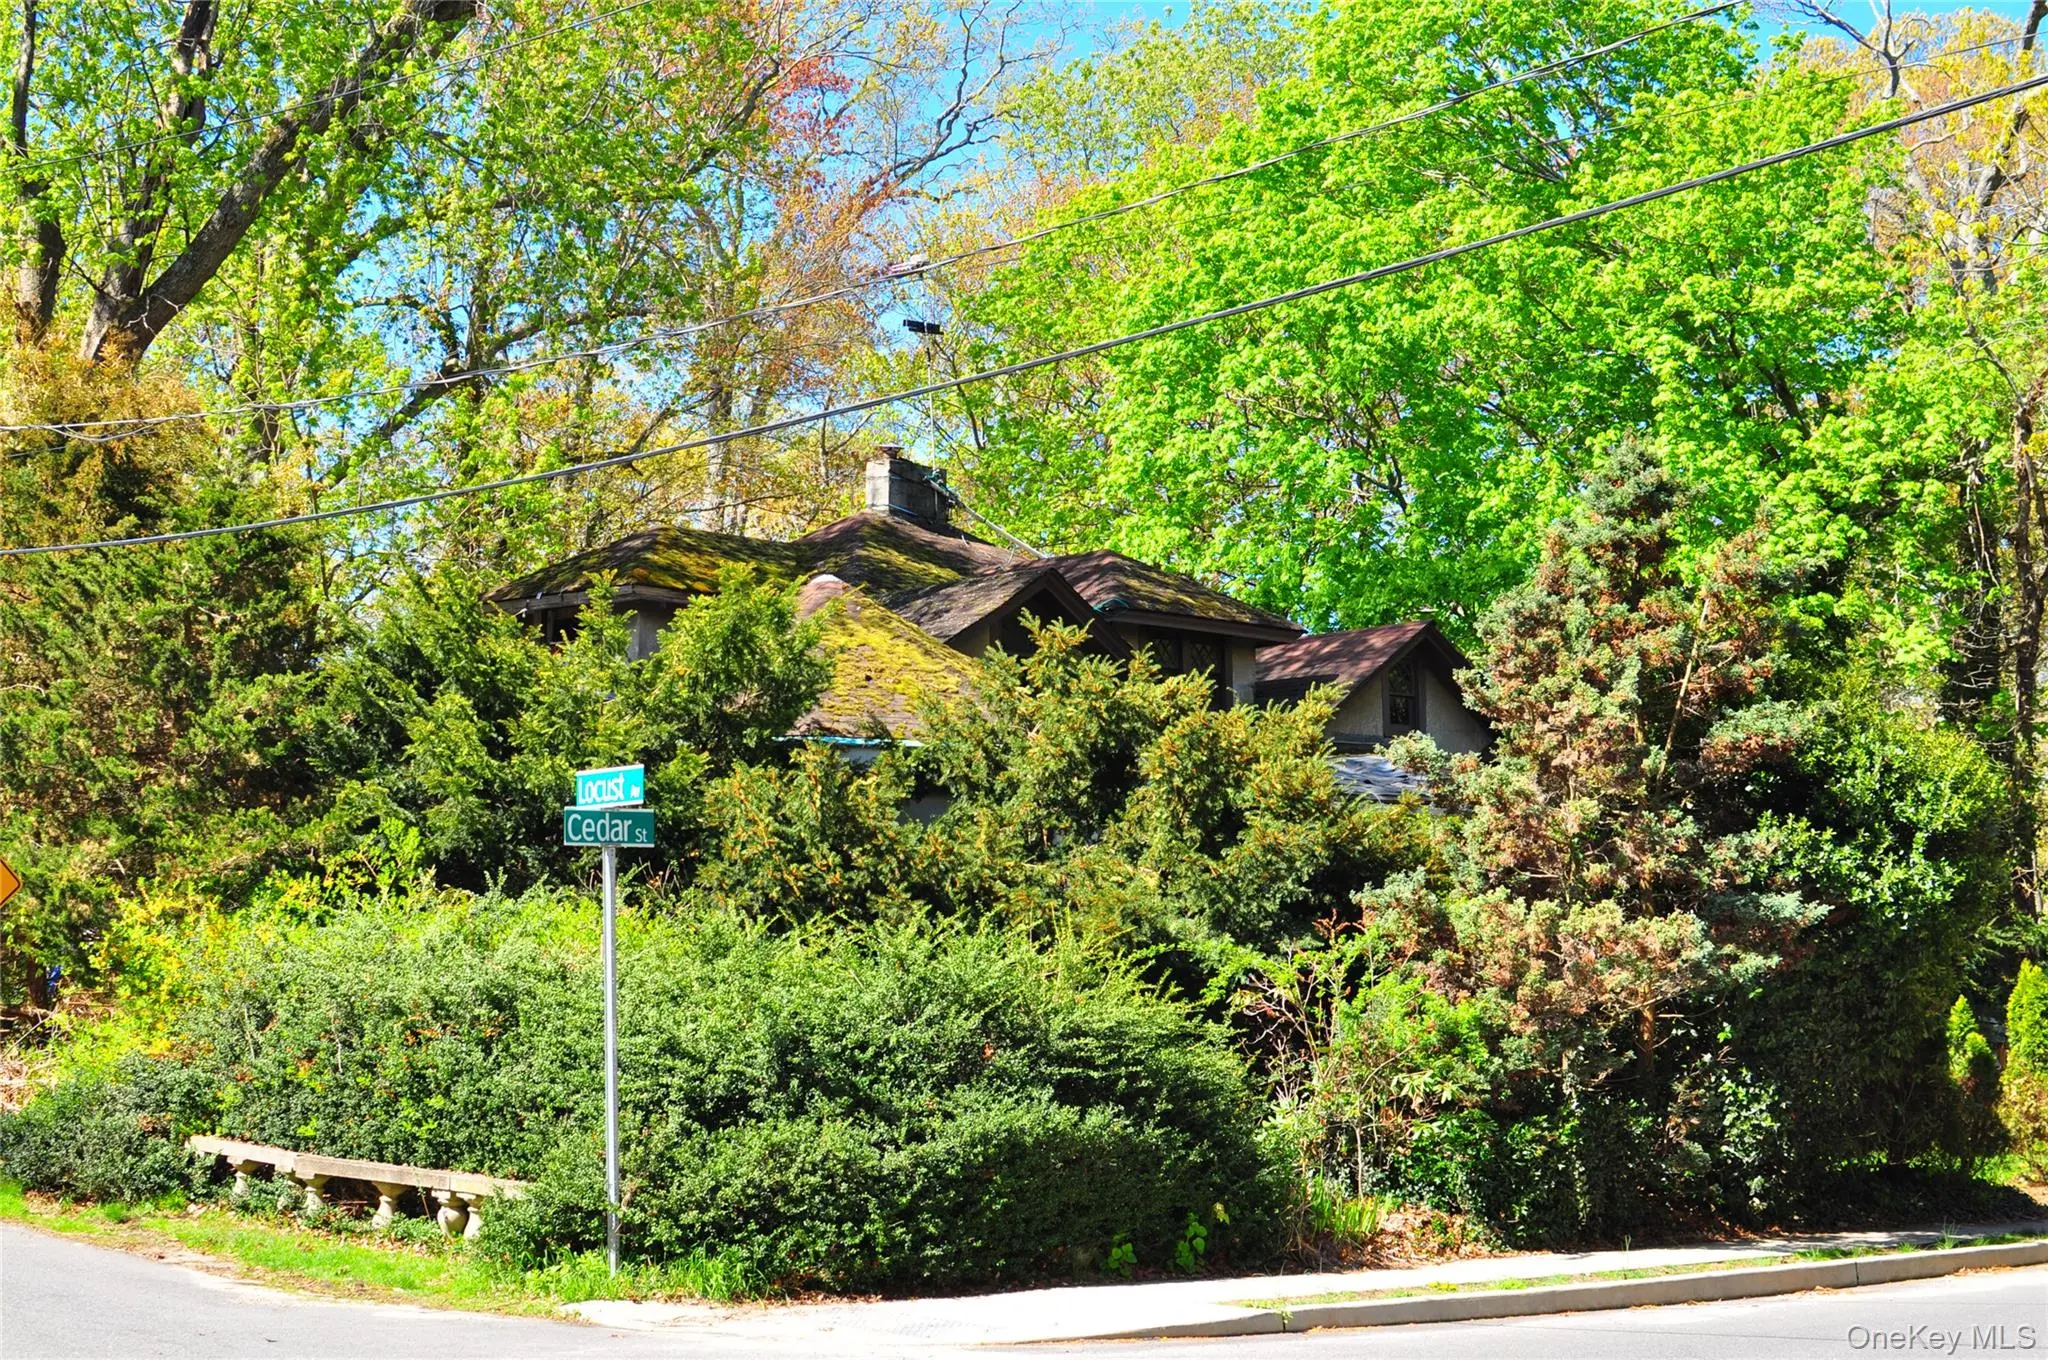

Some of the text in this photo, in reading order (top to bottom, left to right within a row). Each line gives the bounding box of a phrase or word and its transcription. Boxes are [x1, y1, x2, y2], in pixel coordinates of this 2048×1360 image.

[578, 772, 624, 803] Locust
[567, 813, 647, 842] Cedar St
